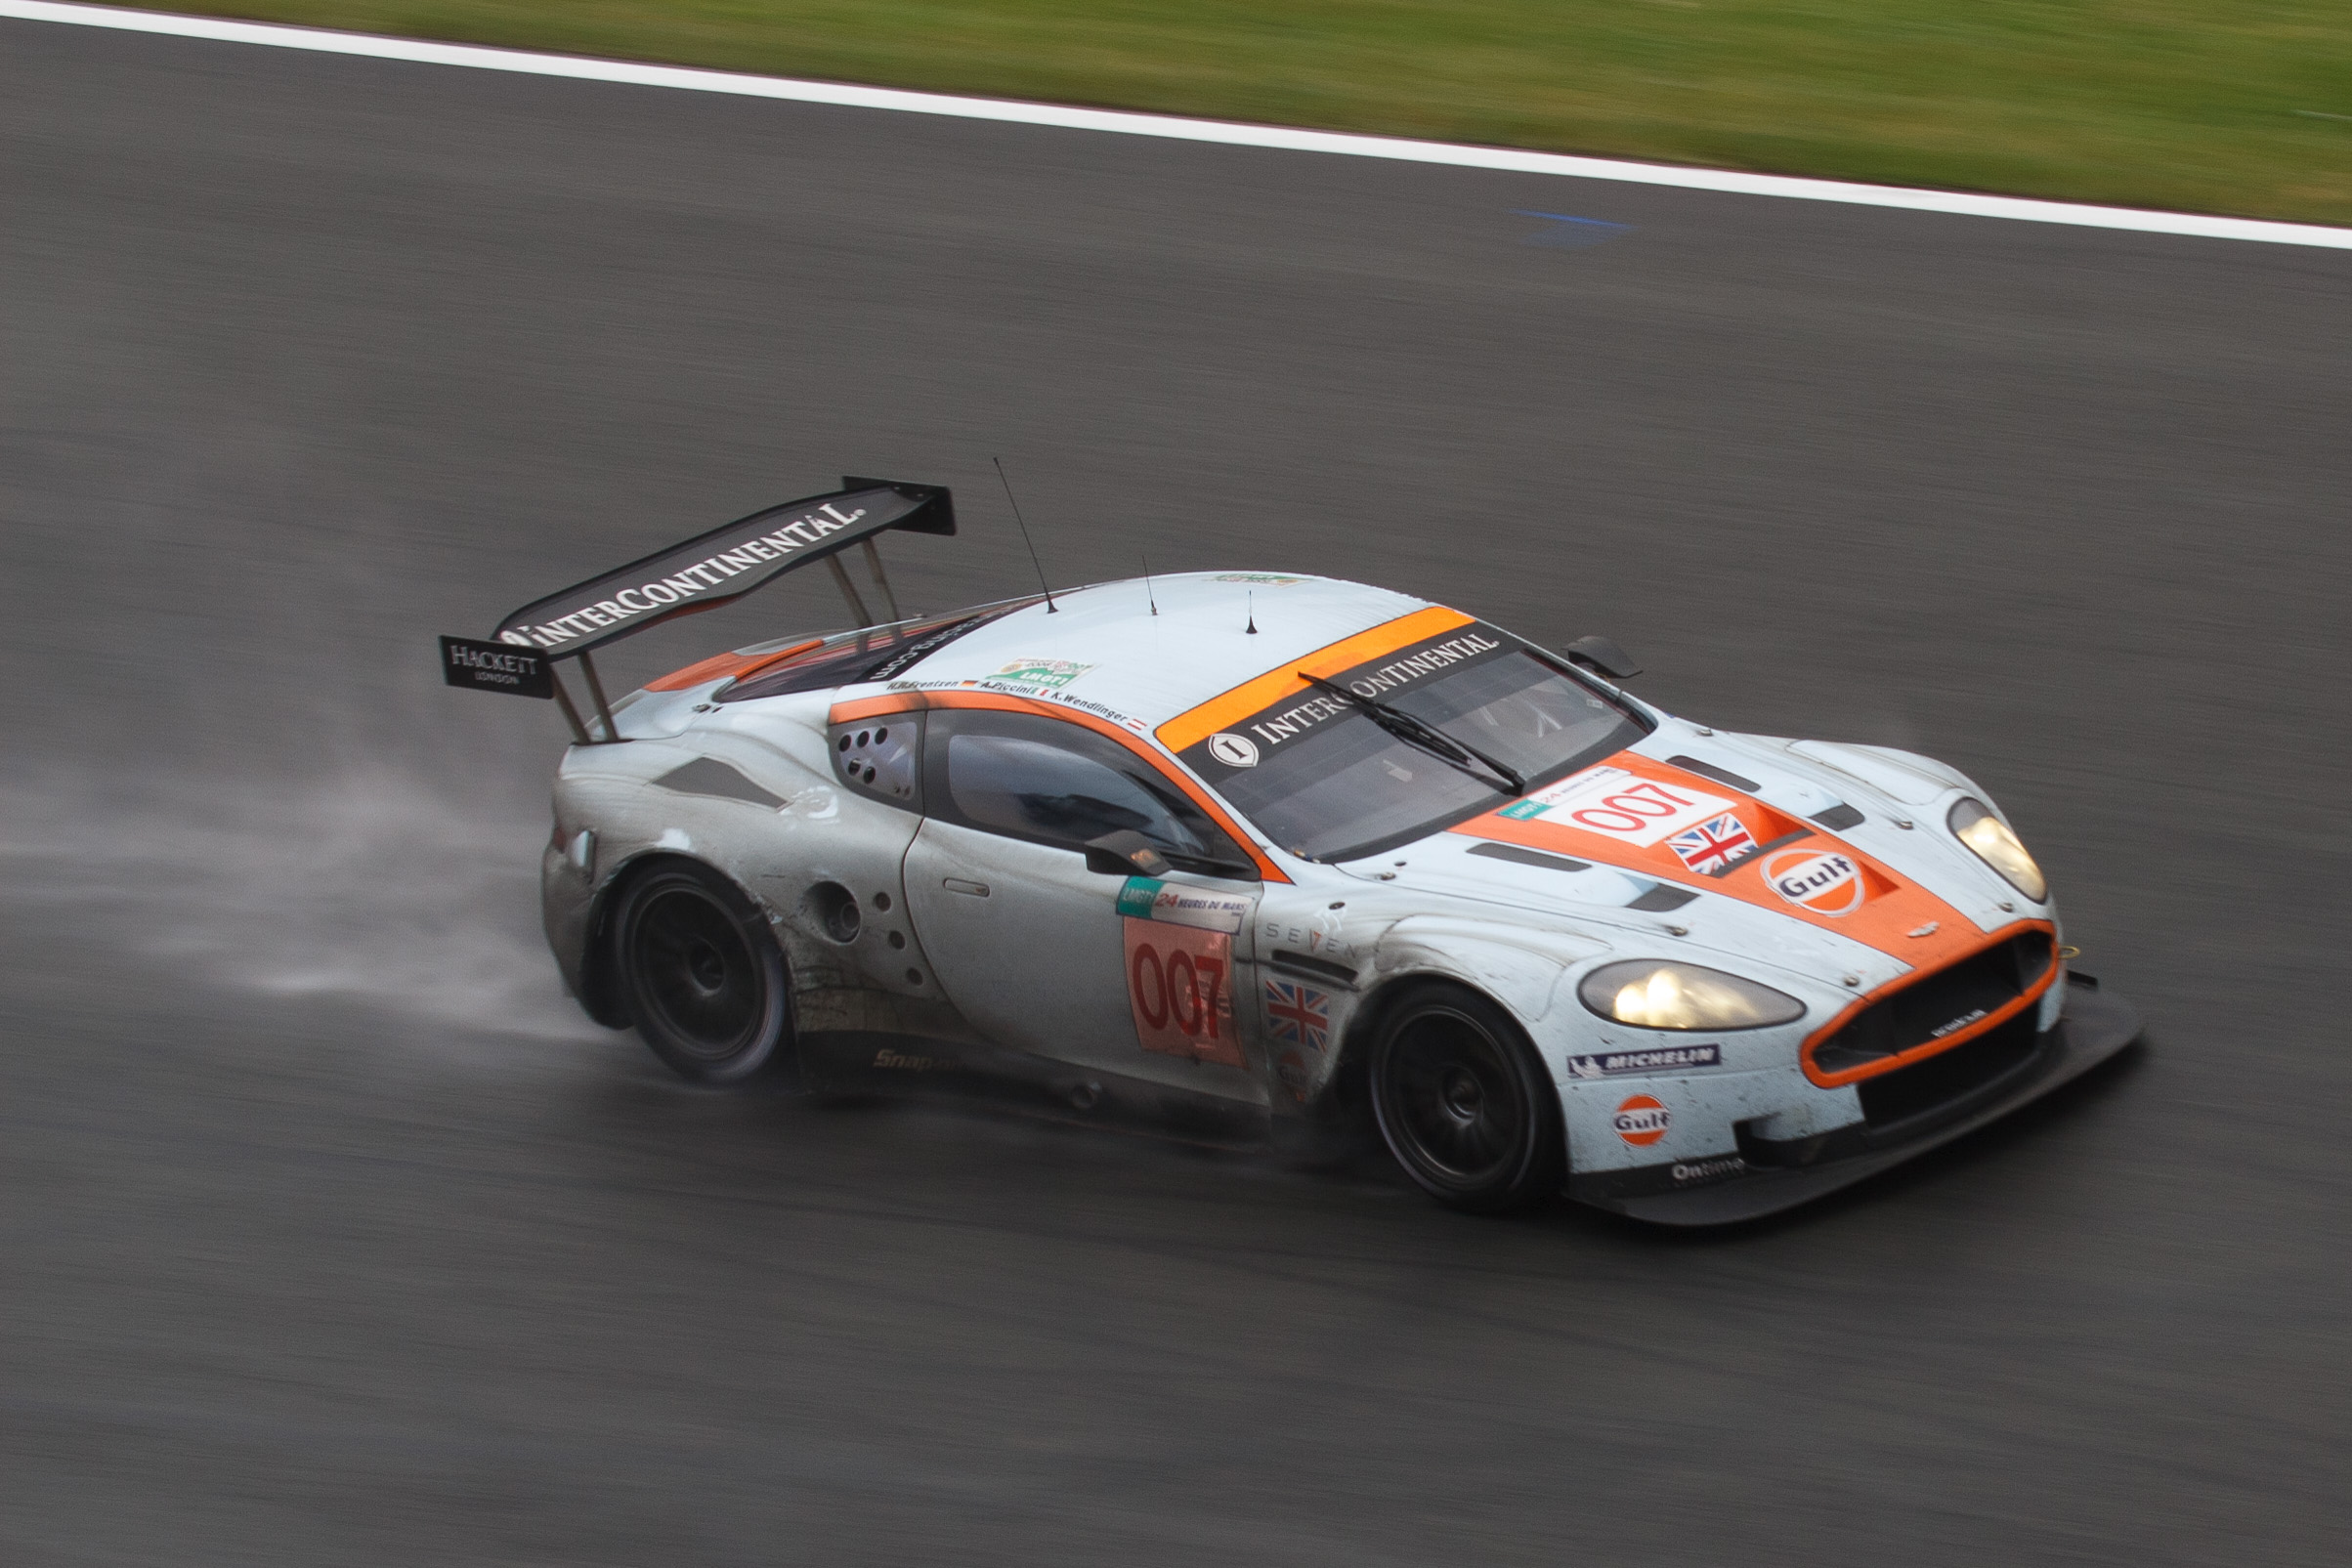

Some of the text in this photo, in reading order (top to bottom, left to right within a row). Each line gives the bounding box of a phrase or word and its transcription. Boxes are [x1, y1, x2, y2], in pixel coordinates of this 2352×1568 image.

[517, 503, 859, 647] INTERCONTINENTAL
[450, 645, 538, 675] HACKETT
[474, 670, 521, 684] LONDON
[1571, 782, 1694, 832] 007
[1778, 856, 1852, 897] Gulf
[1155, 892, 1180, 909] 24
[1133, 943, 1222, 1038] 007
[1605, 1048, 1715, 1069] MICHELIN
[1614, 1111, 1671, 1131] Gulf
